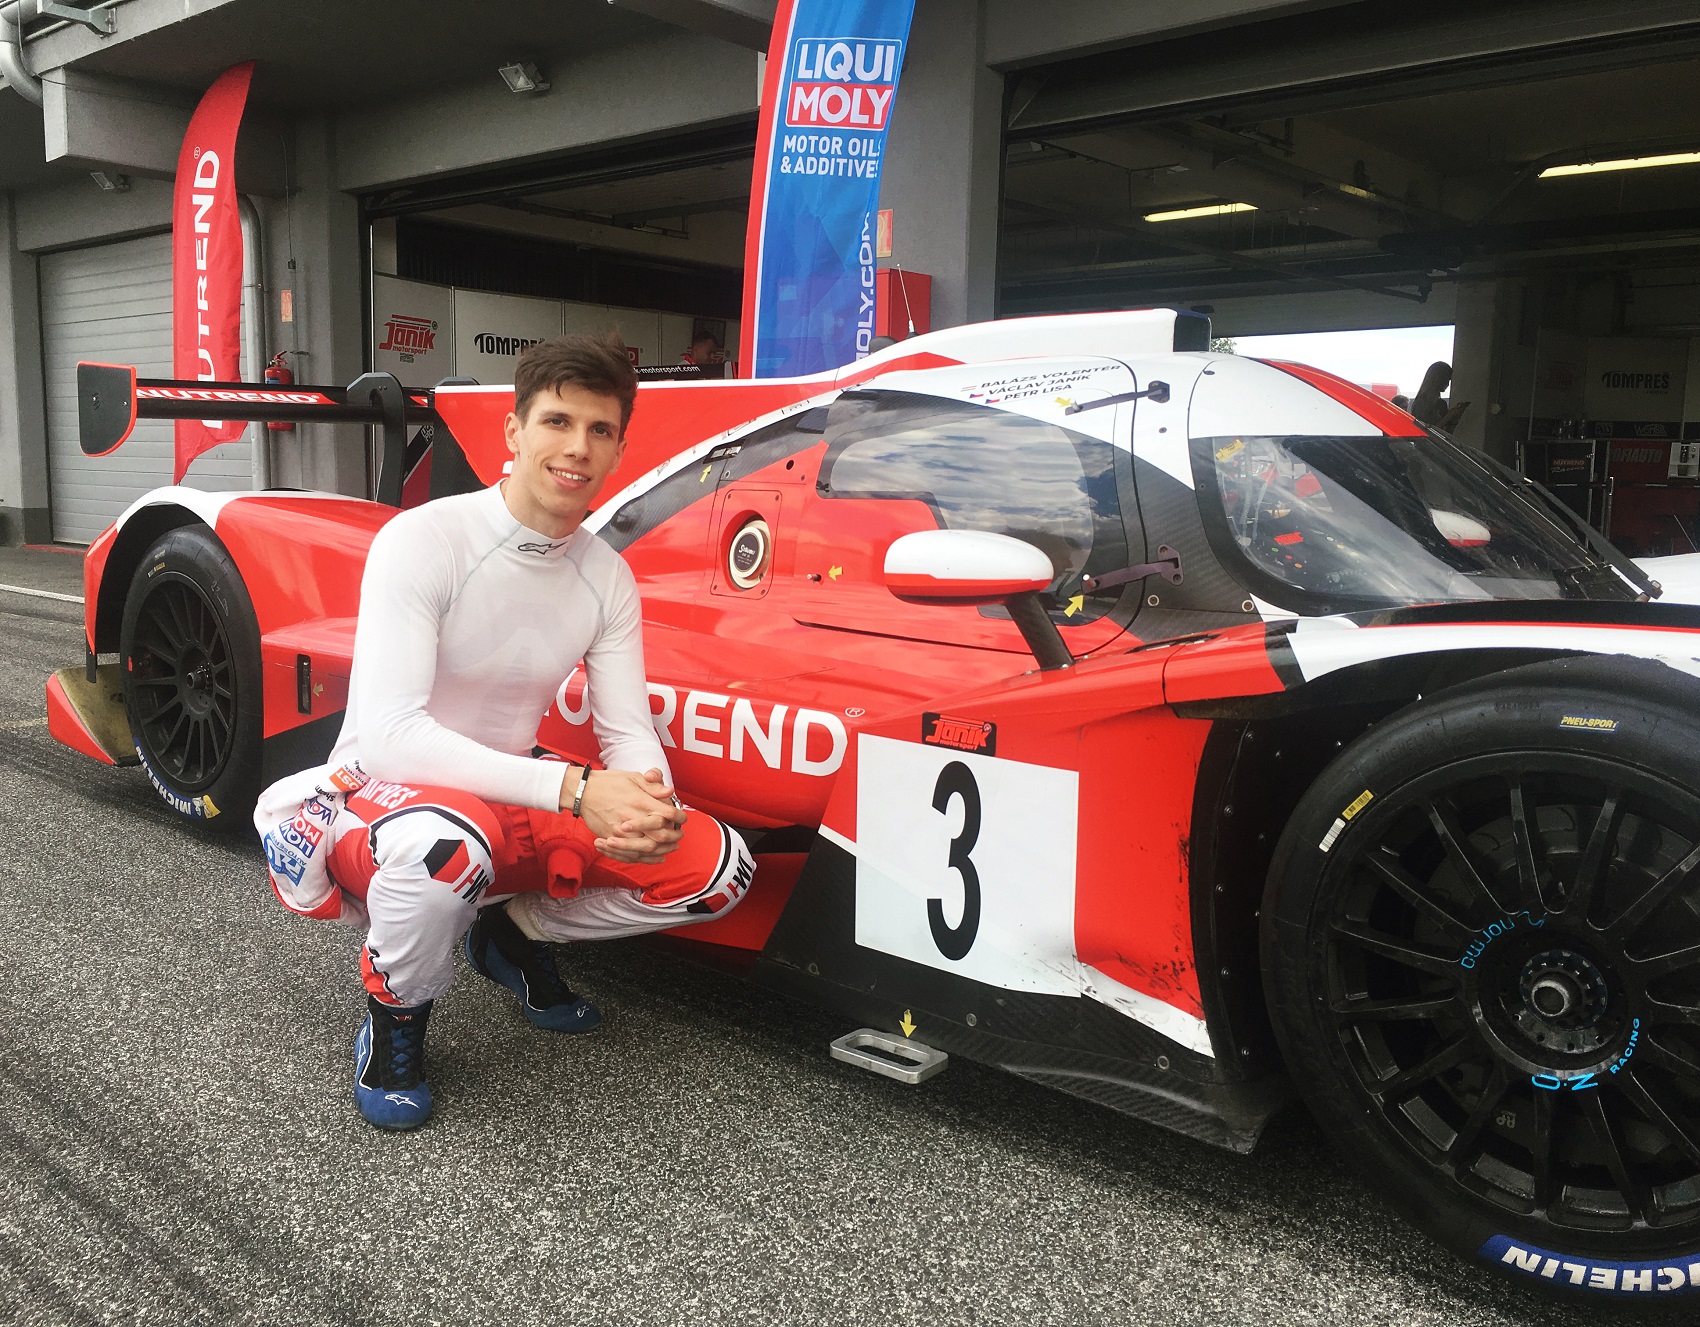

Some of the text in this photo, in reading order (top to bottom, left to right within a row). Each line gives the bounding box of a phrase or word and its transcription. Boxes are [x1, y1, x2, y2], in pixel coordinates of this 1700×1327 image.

[797, 42, 896, 82] LIQUI
[792, 86, 893, 125] MOLY
[783, 135, 842, 155] MOTOR
[192, 150, 222, 429] UTREND
[988, 380, 1044, 394] VÁCLAV
[1004, 384, 1072, 400] PETR LISA
[1602, 371, 1669, 389] TOMPRES
[136, 389, 315, 404] NUTREND
[939, 739, 979, 751] motorsport
[136, 746, 192, 815] MICHELIN
[927, 761, 981, 961] 3
[1609, 1017, 1641, 1075] RACING
